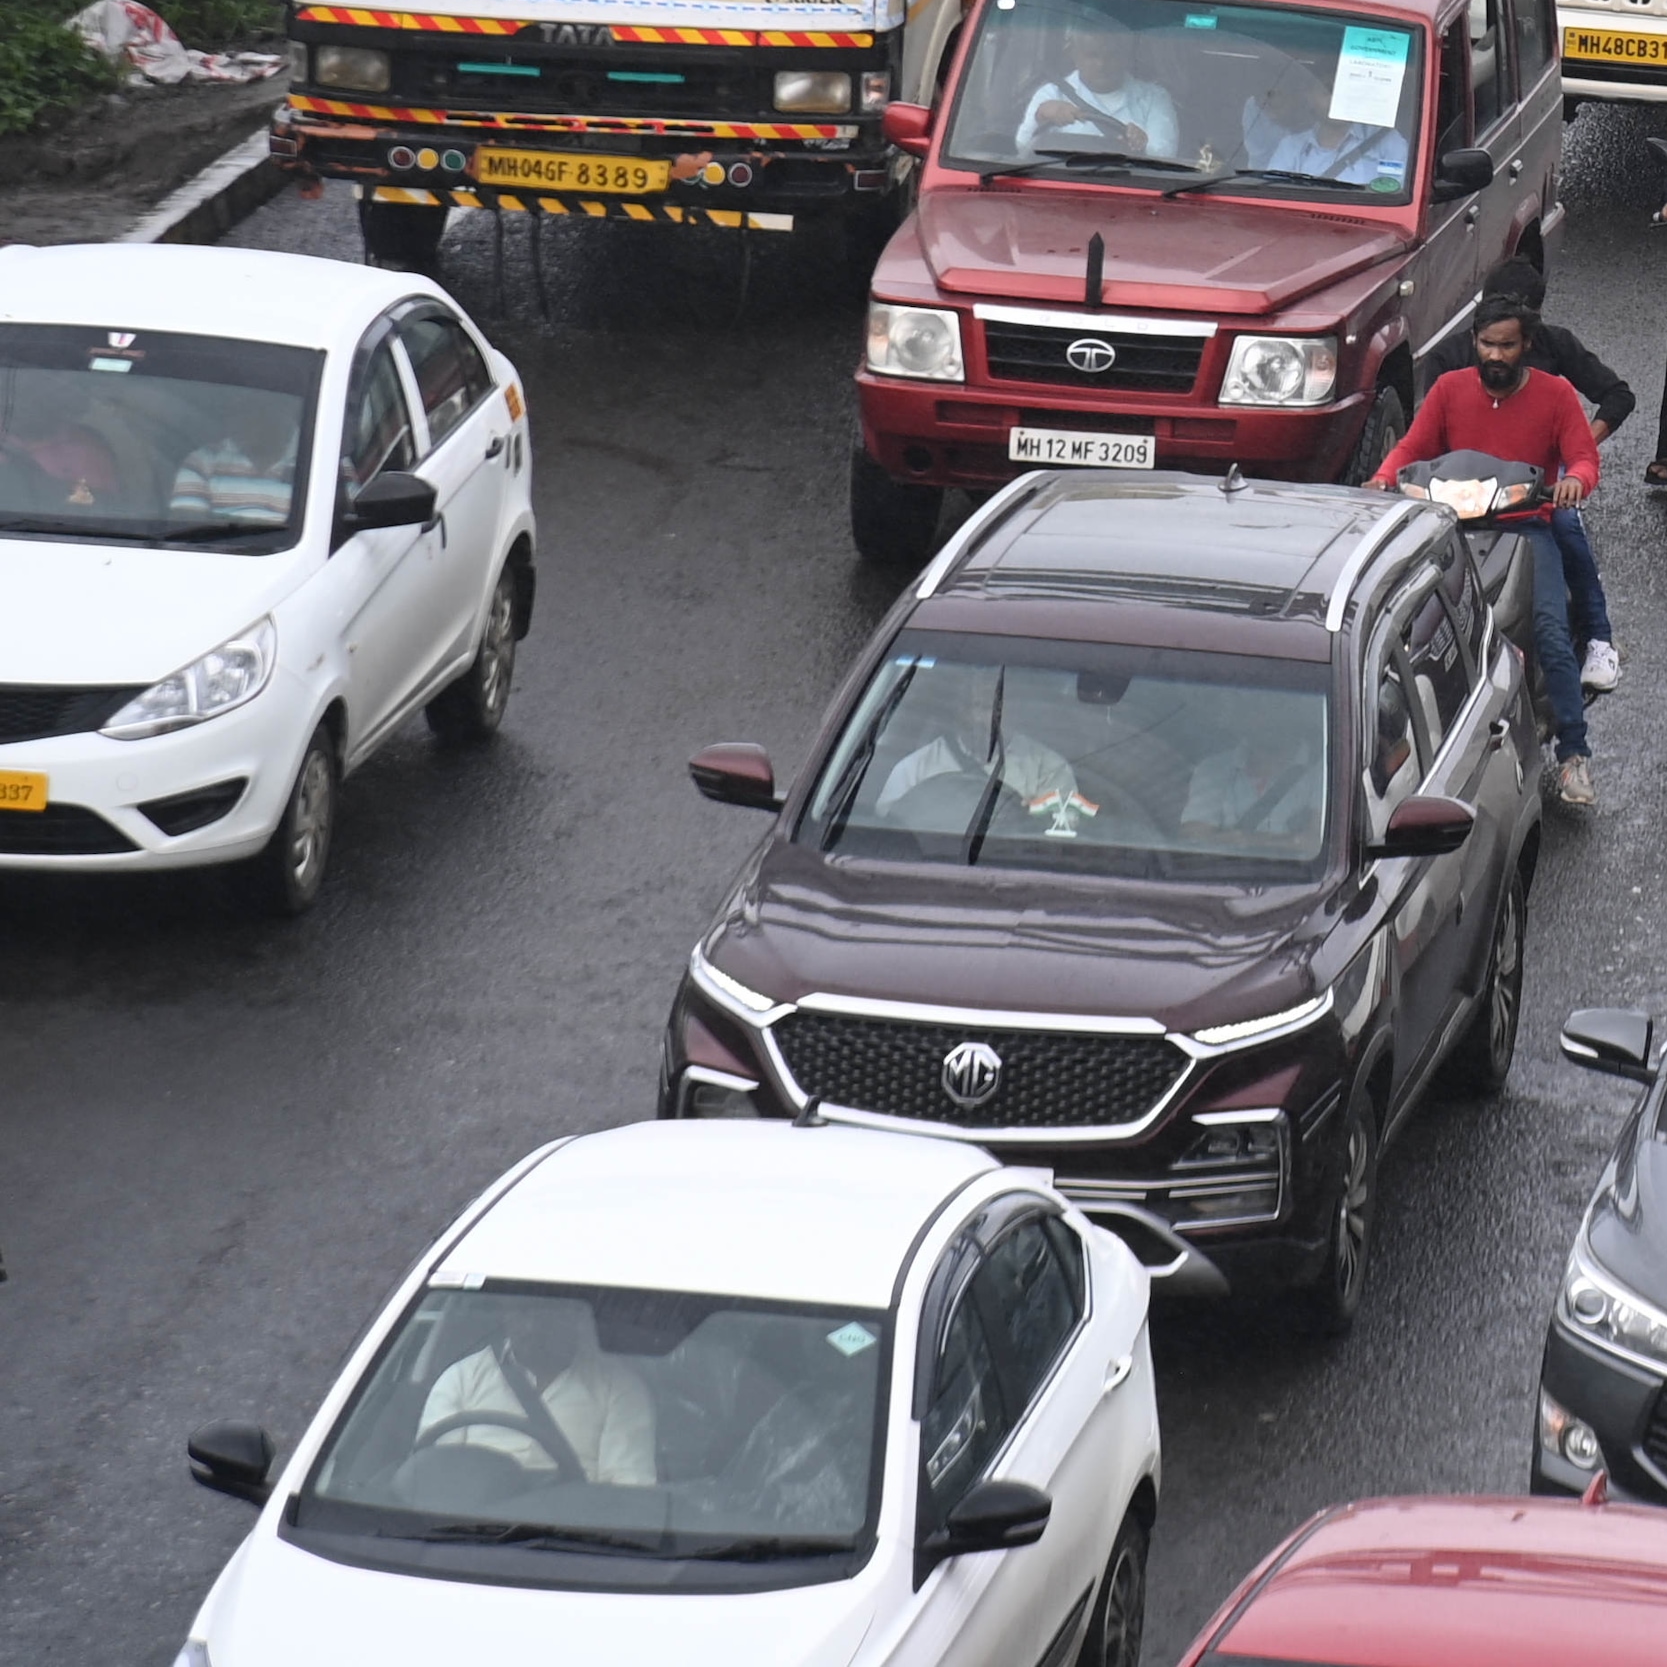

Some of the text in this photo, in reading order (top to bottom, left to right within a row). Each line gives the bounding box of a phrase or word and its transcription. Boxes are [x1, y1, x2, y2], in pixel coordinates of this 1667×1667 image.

[539, 22, 616, 47] TATA
[1016, 437, 1148, 467] MH 12 MF 3209
